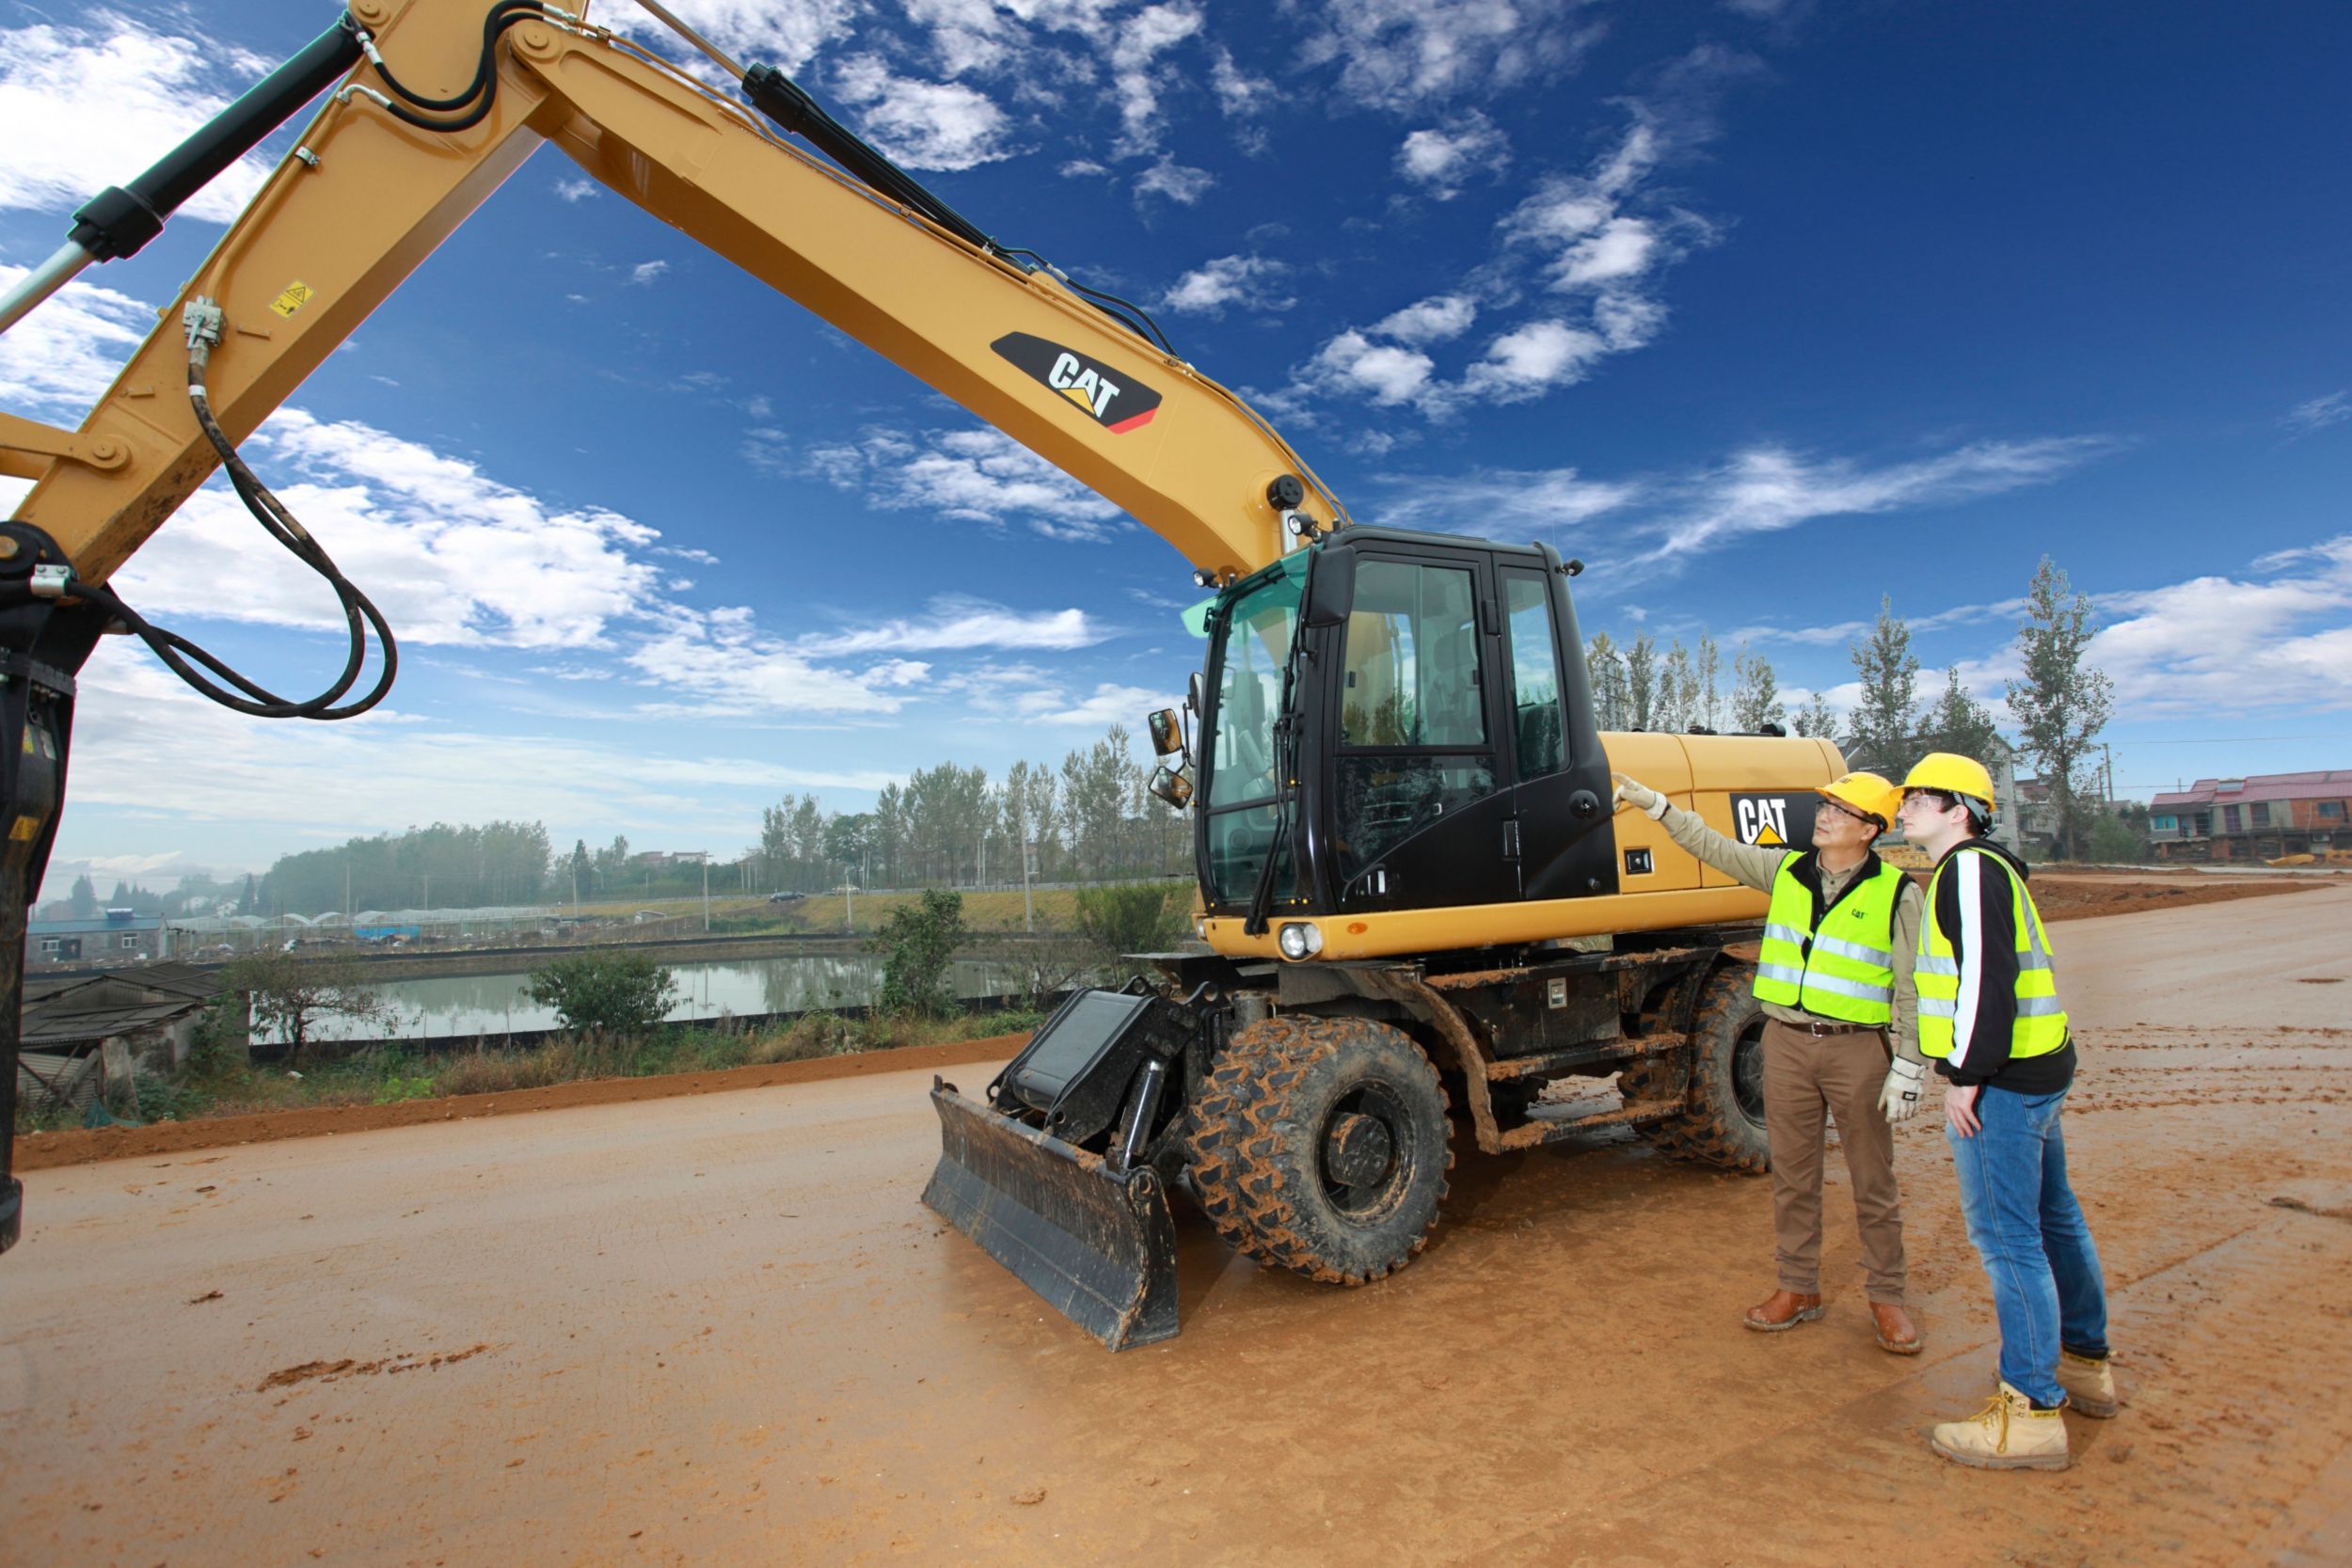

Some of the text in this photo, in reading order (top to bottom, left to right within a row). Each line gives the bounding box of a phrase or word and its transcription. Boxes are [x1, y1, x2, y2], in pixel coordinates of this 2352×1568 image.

[1048, 352, 1120, 419] CAT
[1738, 798, 1788, 845] CAT
[1851, 908, 1866, 919] CAT
